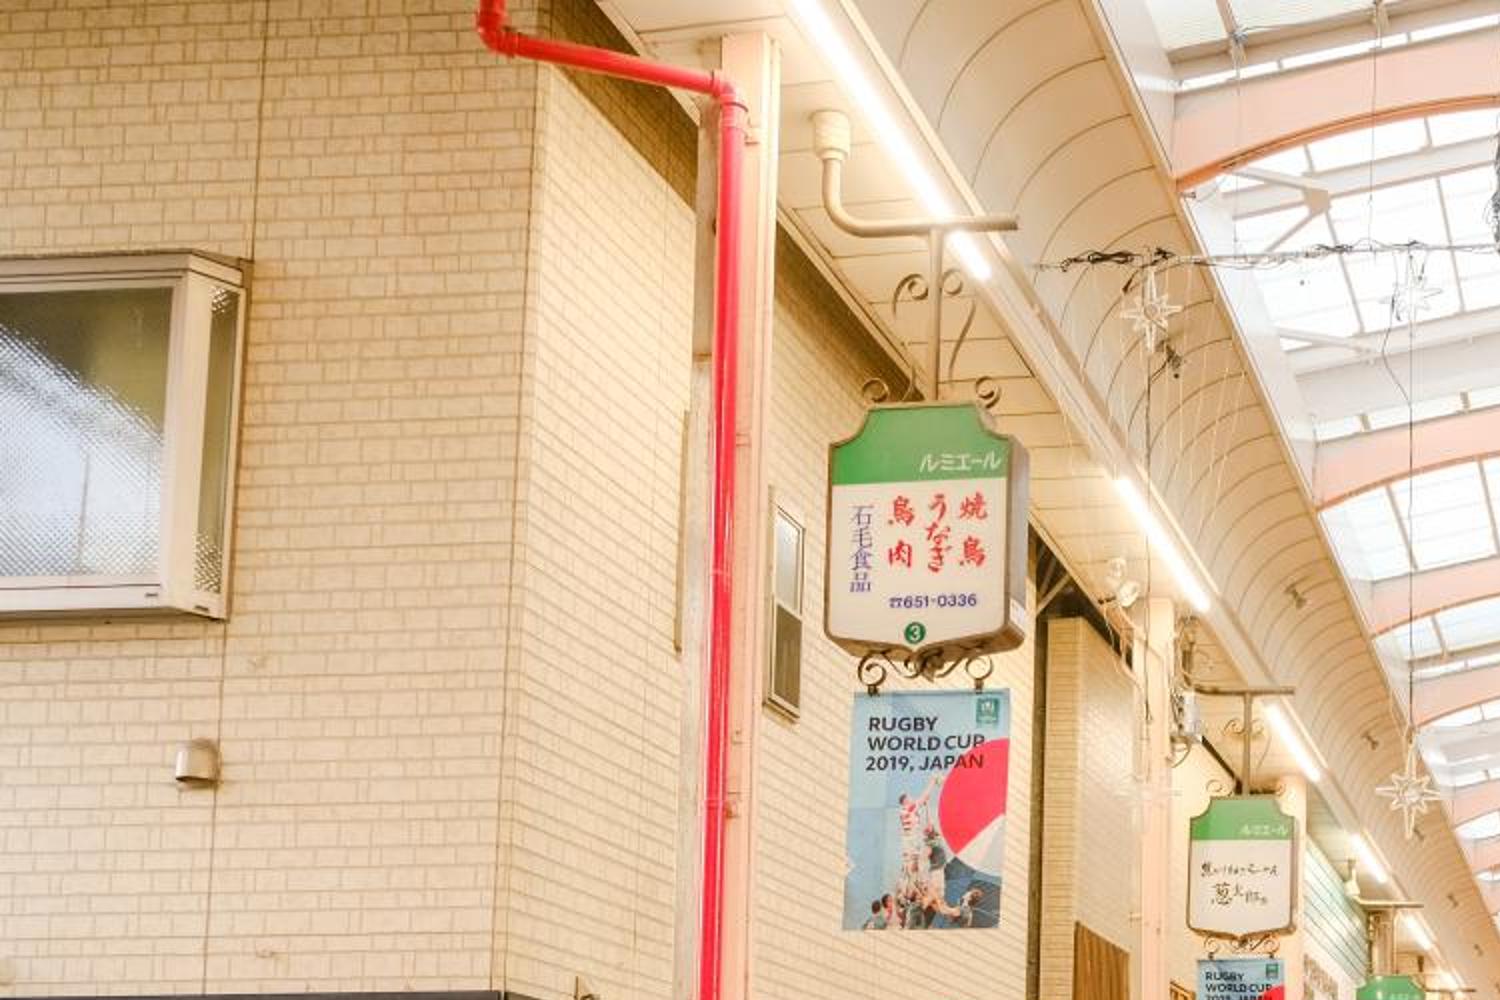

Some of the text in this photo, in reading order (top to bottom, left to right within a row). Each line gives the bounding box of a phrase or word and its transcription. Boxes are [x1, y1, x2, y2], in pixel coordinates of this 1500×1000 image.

[919, 453, 1001, 472] ルミエール
[888, 495, 916, 568] 鳥肉
[926, 493, 951, 573] うなぎ
[959, 491, 988, 567] 焼鳥
[849, 504, 874, 592] 石毛食品
[903, 594, 977, 610] 651-0336
[868, 716, 938, 732] RUGBY
[867, 733, 986, 752] WORLD CUP
[865, 754, 984, 772] 2019, JAPAN
[1205, 971, 1245, 981] RUGBY
[1205, 984, 1247, 993] WORLD
